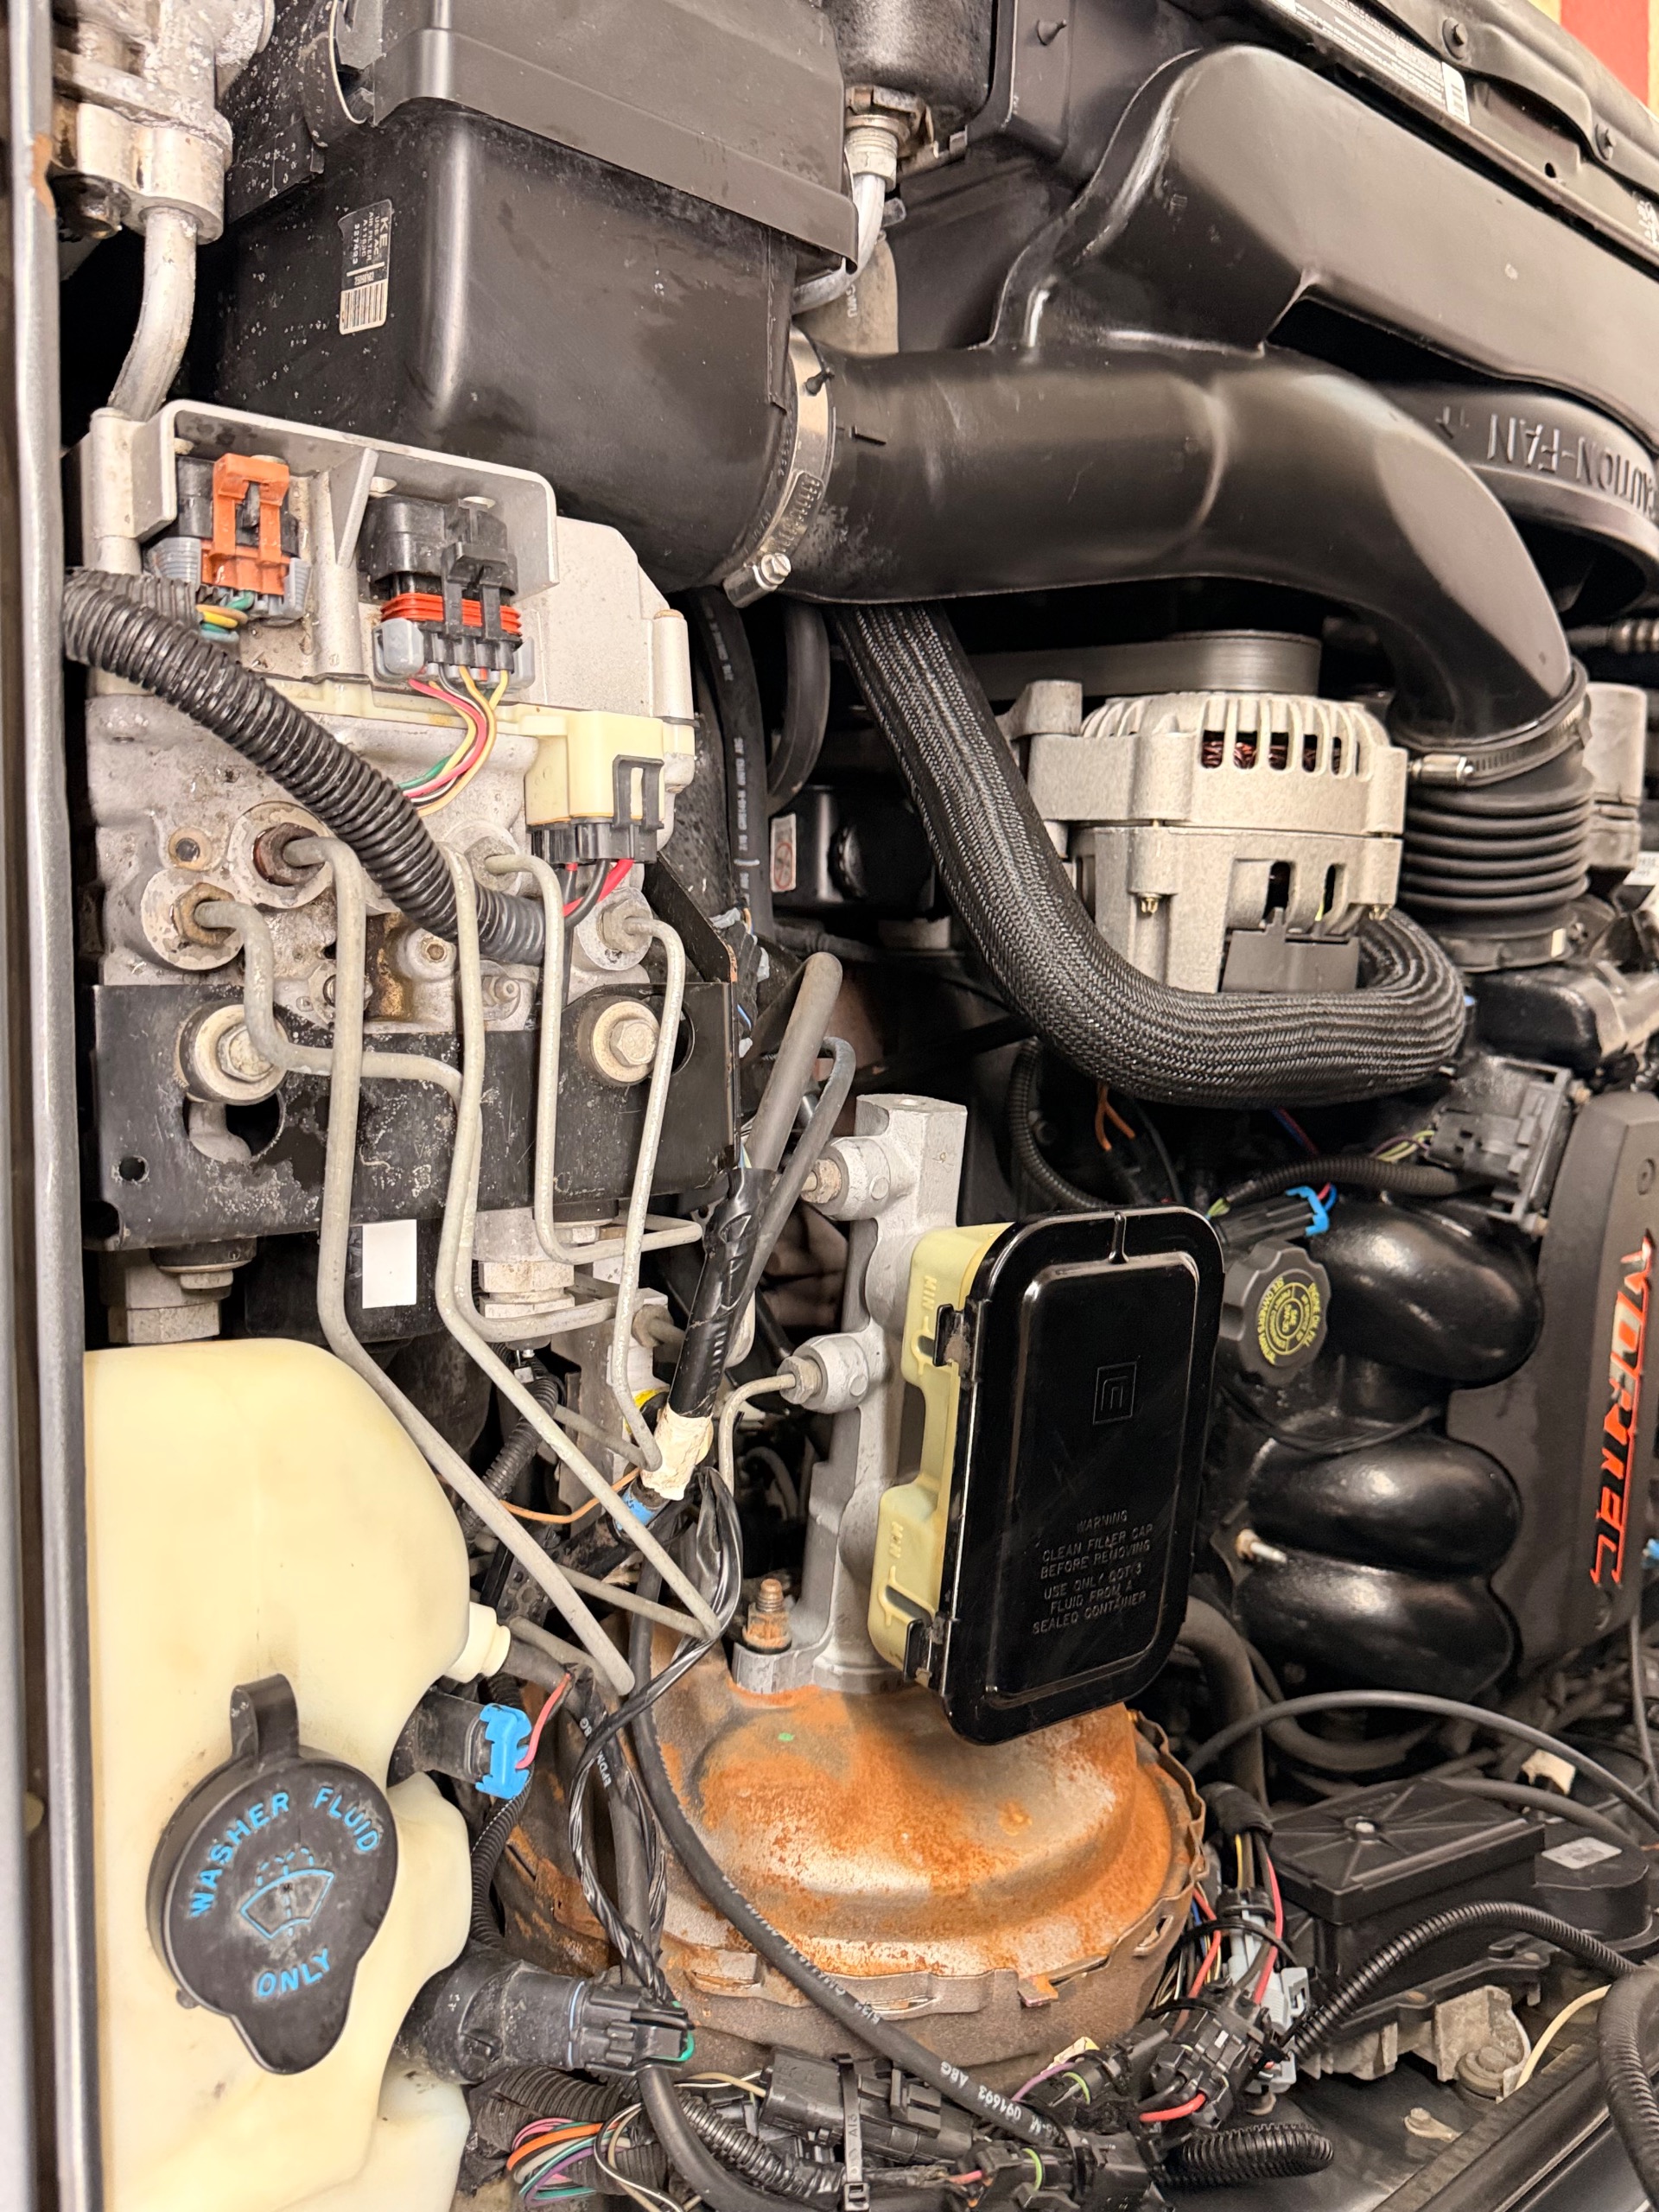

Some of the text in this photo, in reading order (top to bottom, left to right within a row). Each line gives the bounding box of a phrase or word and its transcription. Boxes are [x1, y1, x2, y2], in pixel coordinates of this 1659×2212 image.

[373, 238, 379, 256] AC
[922, 1274, 938, 1311] MIN
[1590, 1232, 1654, 1585] VORTEC
[1077, 1510, 1128, 1534] WARNING
[1040, 1539, 1151, 1580] BEFORE REMOVING
[1042, 1523, 1154, 1563] CLEAN FILLER CAP
[1044, 1582, 1069, 1600] USE
[1050, 1594, 1084, 1615] FLUID
[1089, 1583, 1122, 1603] FROM
[1032, 1611, 1079, 1635] SEALED
[579, 1717, 612, 1789] EPDM BG
[188, 1787, 379, 1918] WASHER FLUID
[257, 1948, 331, 1997] ONLY
[940, 2061, 969, 2089] ABG
[977, 2084, 1022, 2125] 091693
